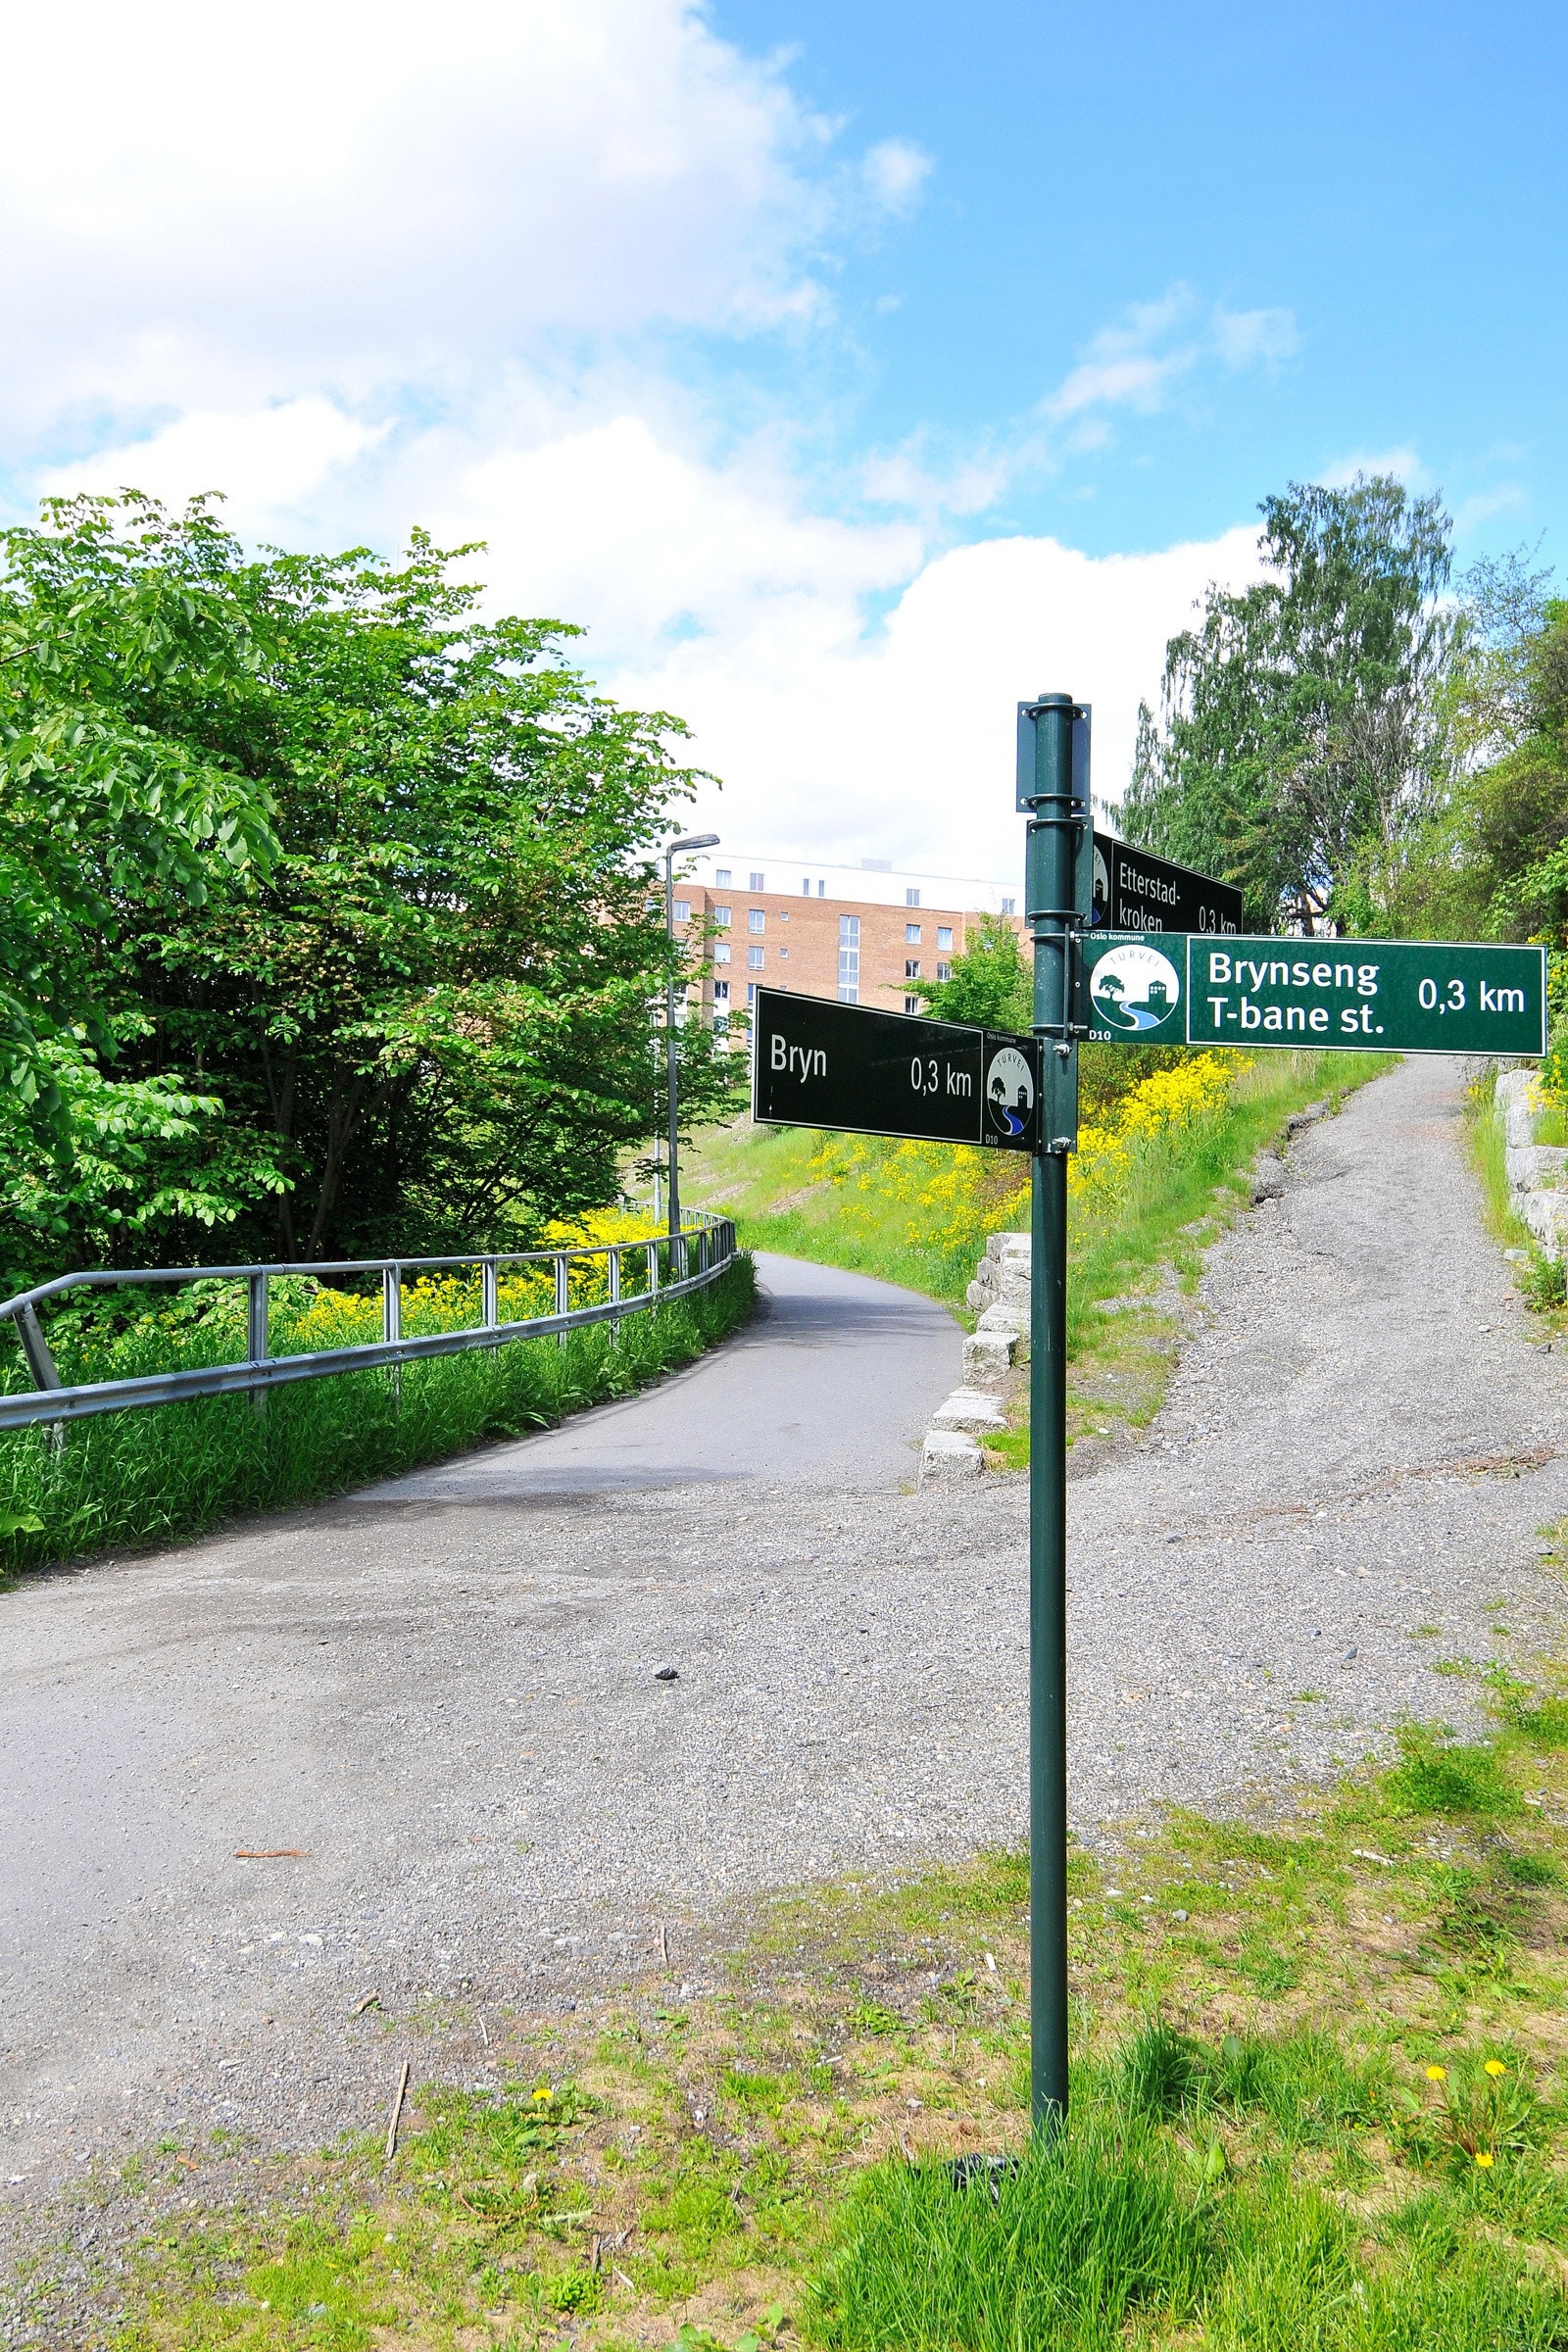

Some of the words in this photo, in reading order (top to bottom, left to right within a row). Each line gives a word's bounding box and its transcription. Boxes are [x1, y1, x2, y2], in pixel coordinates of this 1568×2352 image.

[1120, 861, 1181, 906] Etterstad-
[1119, 898, 1162, 932] kroken
[1220, 912, 1237, 934] km
[1110, 951, 1160, 966] TURVEI
[1209, 952, 1380, 997] Brynseng
[1418, 978, 1466, 1016] 0,3
[1480, 980, 1525, 1012] km
[1207, 997, 1329, 1033] T-bane
[1340, 1004, 1385, 1034] st.
[1089, 1030, 1111, 1041] D10
[770, 1034, 827, 1084] Bryn
[997, 1053, 1025, 1071] TURVEI
[910, 1056, 939, 1098] 0,3
[946, 1061, 972, 1098] km
[985, 1134, 999, 1146] D10
